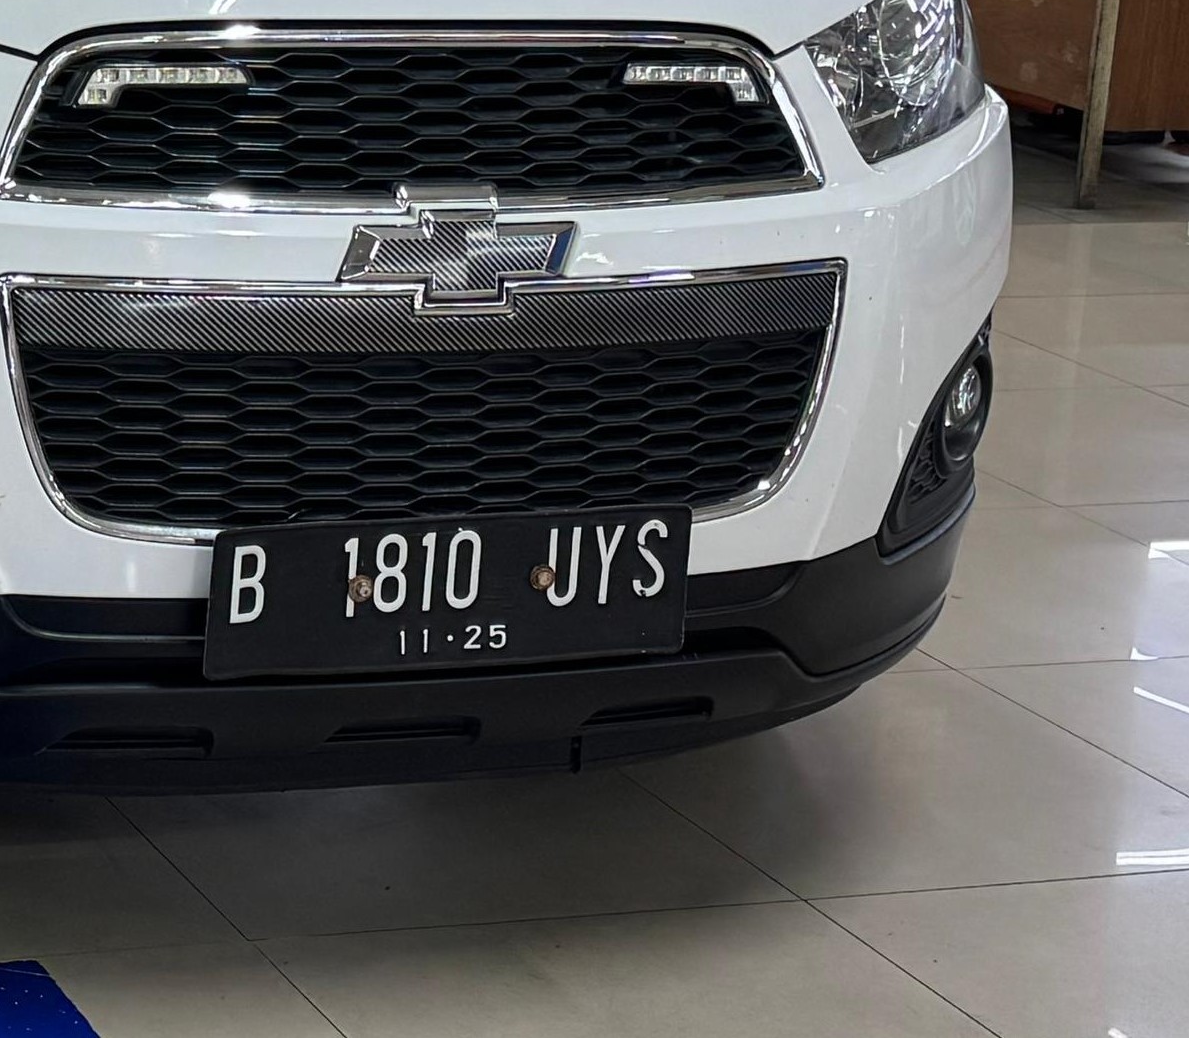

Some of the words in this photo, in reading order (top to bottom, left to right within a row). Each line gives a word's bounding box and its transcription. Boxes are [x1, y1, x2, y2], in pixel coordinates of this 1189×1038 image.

[229, 544, 267, 624] B
[344, 529, 482, 618] 1810
[546, 519, 669, 607] UYS
